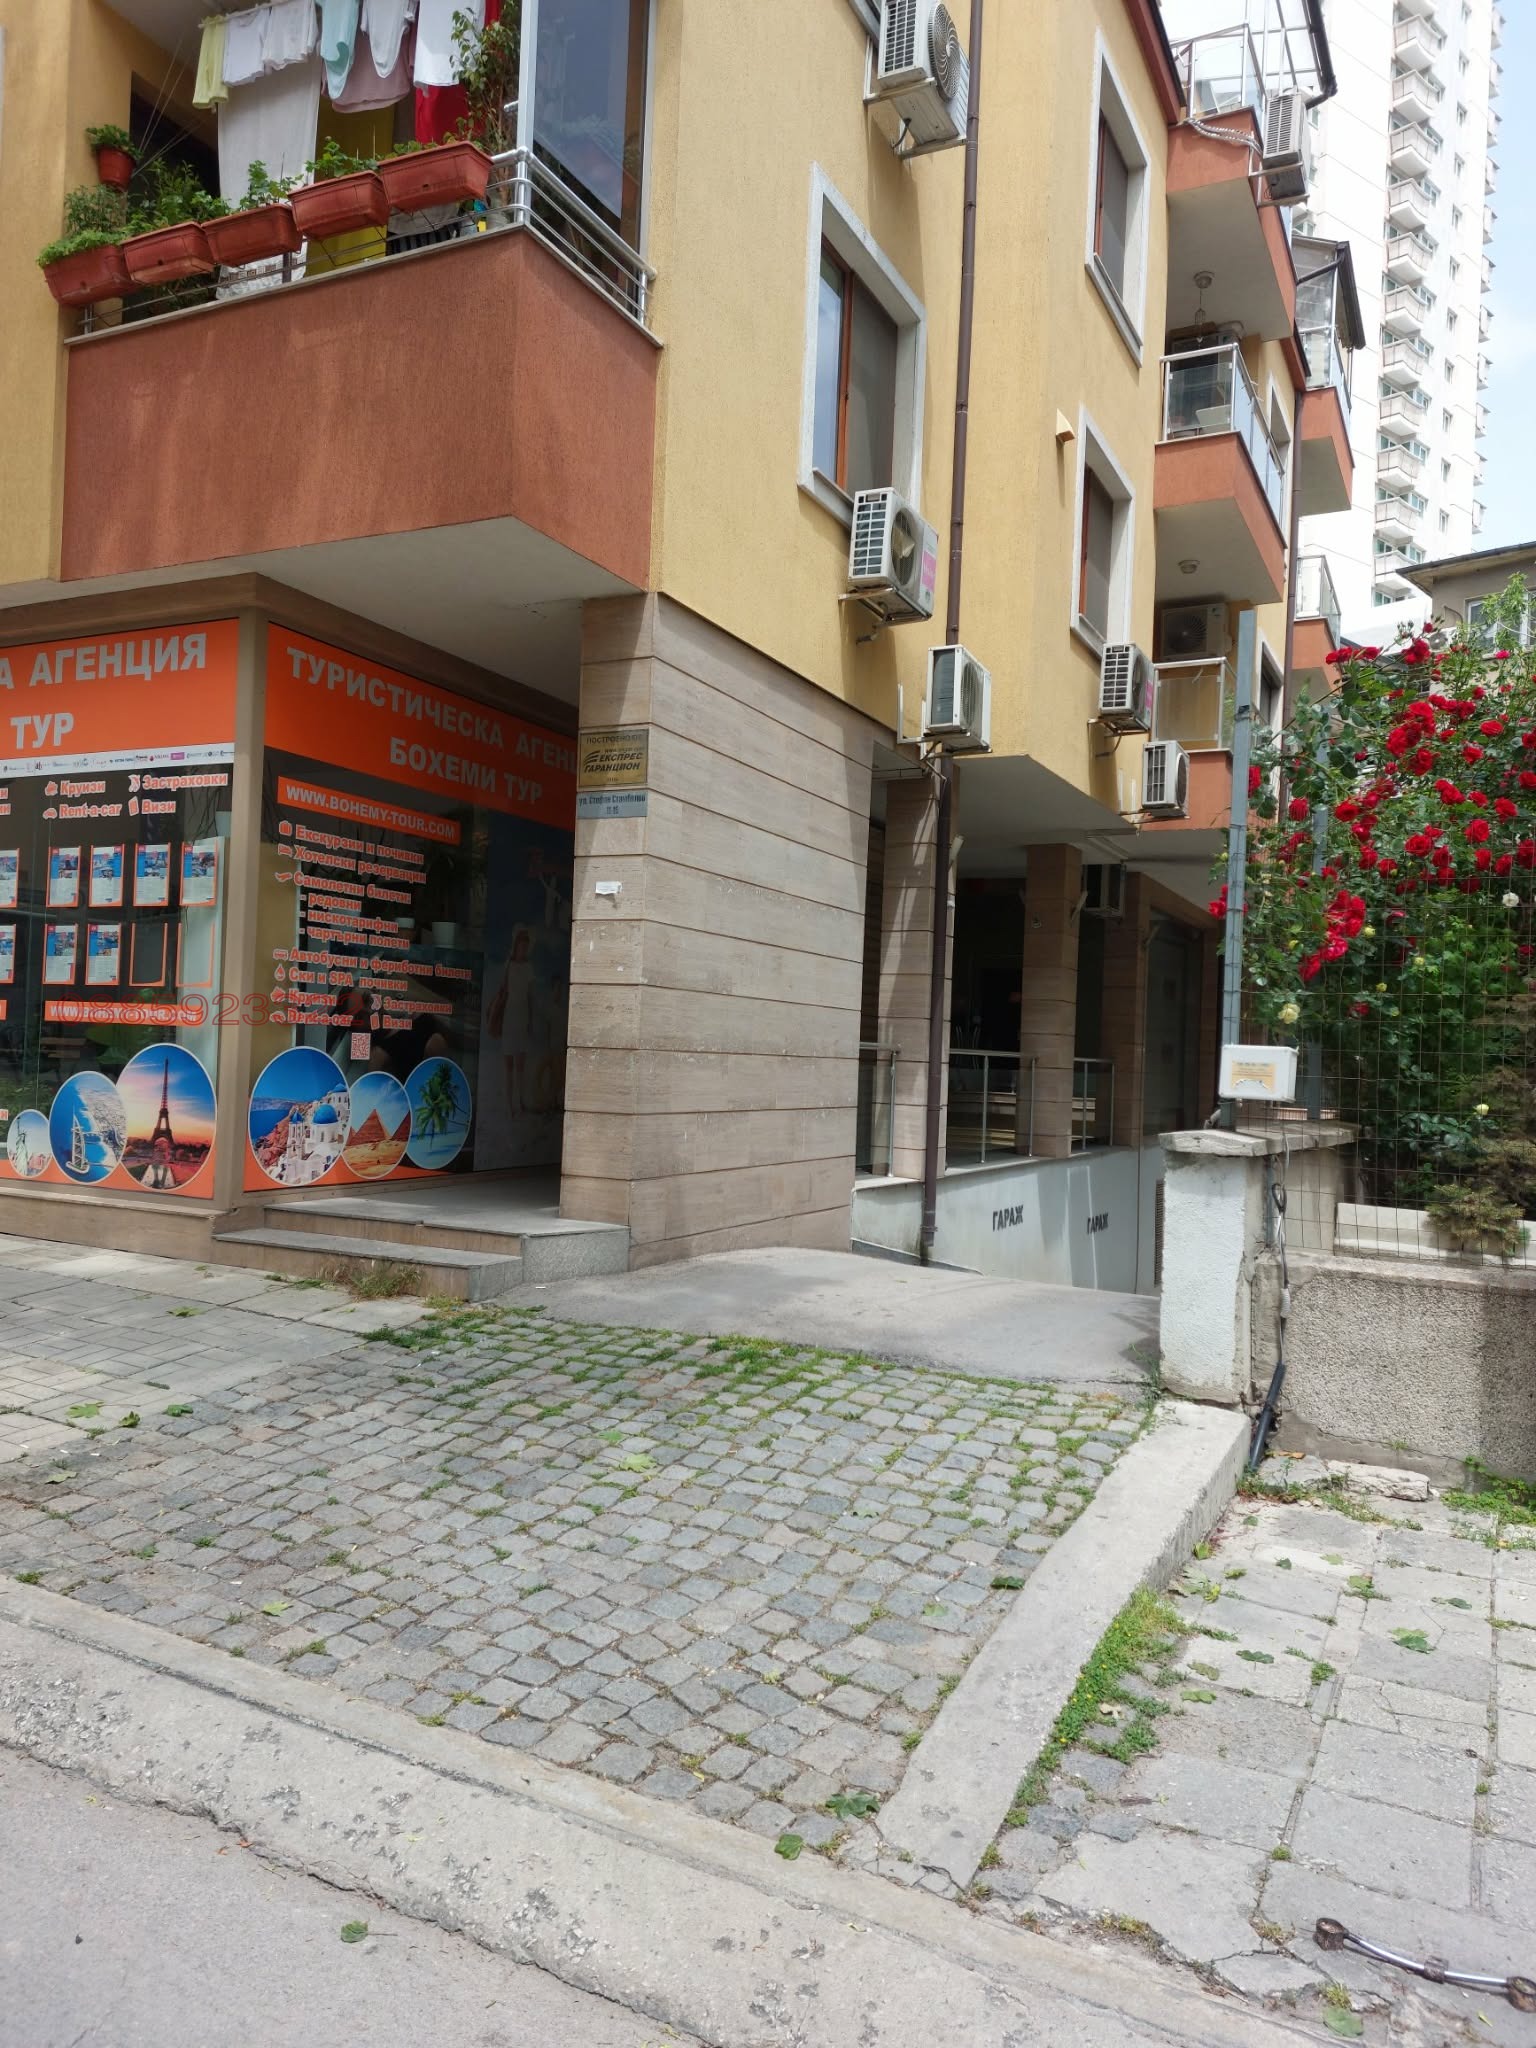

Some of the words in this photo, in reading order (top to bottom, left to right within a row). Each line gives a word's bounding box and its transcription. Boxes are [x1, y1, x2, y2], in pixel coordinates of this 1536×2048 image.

[29, 633, 207, 687] АГЕНЦИЯ
[287, 646, 504, 748] ТУРИСТИЧЕСКА
[10, 713, 74, 750] ТУР
[584, 762, 640, 774] ГАРАНЦИОН
[599, 753, 643, 763] ЕКСПРЕС
[389, 737, 496, 793] БОХЕМИ
[504, 773, 543, 805] ТУР
[60, 781, 106, 798] Круизи
[142, 774, 228, 791] Застраховки
[59, 802, 122, 819] Rent-a-car
[142, 800, 176, 814] Визи
[286, 785, 456, 838] WWW.BOHEMY-TOUR.COM
[295, 824, 364, 853] Екскурзии
[377, 844, 424, 864] почивки
[294, 845, 356, 871] Хотелски
[358, 861, 426, 884] резервации
[294, 871, 364, 896] Самолетни
[308, 893, 362, 911] редовни
[307, 910, 399, 933] нискотарифни
[307, 927, 367, 946] чартърни
[290, 949, 358, 970] Автобусни
[289, 967, 314, 984] Ски
[329, 971, 353, 987] SPA
[358, 974, 408, 991] почивки
[382, 1015, 413, 1030] Визи
[992, 1205, 1024, 1232] ГАРАЖ
[1087, 1212, 1109, 1235] ГАРАЖ
